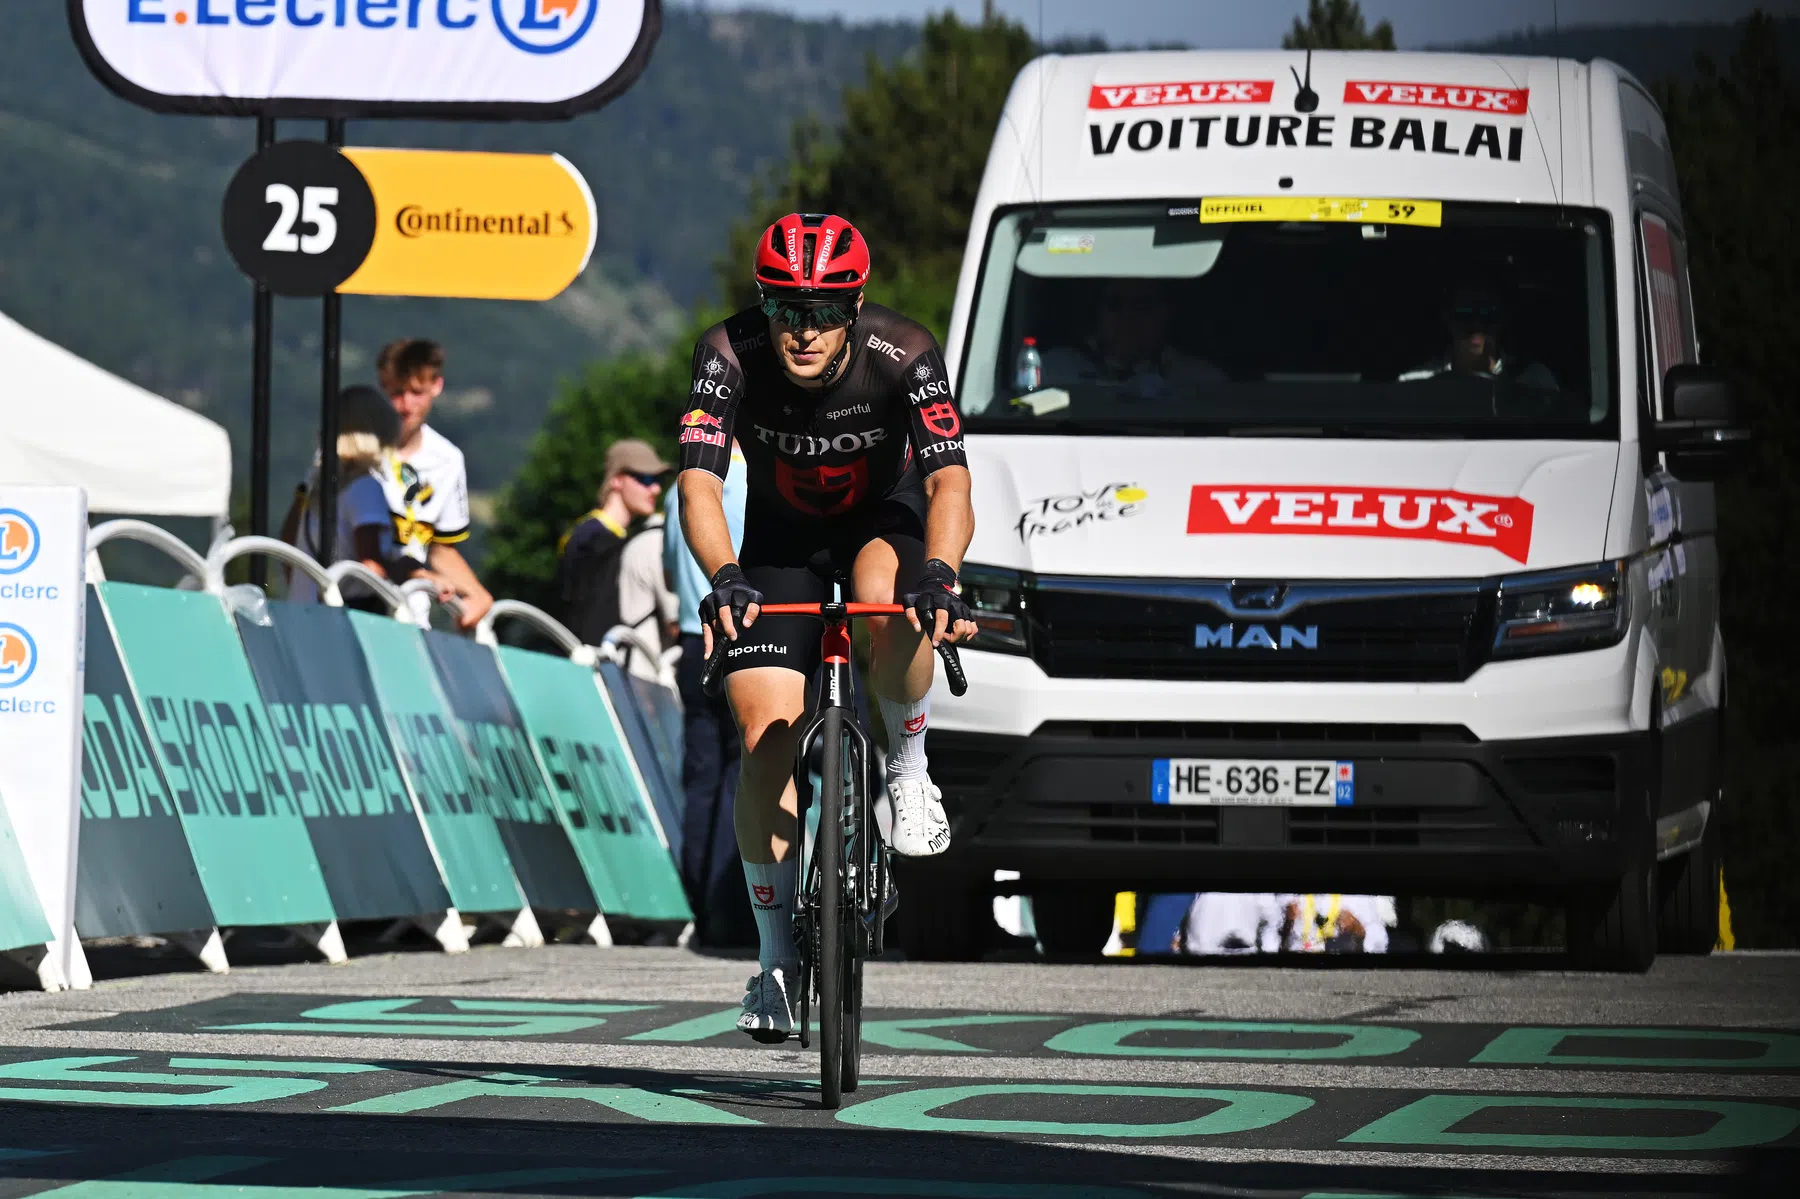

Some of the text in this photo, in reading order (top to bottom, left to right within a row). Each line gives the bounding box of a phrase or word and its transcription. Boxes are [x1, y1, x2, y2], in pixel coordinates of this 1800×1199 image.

[1101, 83, 1253, 107] VELUX
[1356, 84, 1509, 111] VELUX
[1090, 114, 1523, 162] VOITURE BALAI
[262, 184, 339, 254] 25
[395, 204, 551, 239] Continental
[1204, 203, 1265, 215] OFFICIEL
[1386, 203, 1416, 219] 59
[787, 233, 798, 264] TUDOR
[820, 234, 835, 263] TUDOR
[866, 333, 907, 362] BMC
[908, 380, 949, 405] MSC
[826, 402, 872, 420] sportful
[689, 427, 727, 448] Bull
[753, 423, 888, 456] TUDOR
[920, 440, 966, 459] TUDO
[1210, 490, 1500, 537] VELUX
[0, 582, 59, 600] clerc
[1195, 624, 1318, 650] MAN
[727, 643, 788, 658] sportful
[0, 695, 57, 714] clerc
[753, 902, 784, 912] TUDOR
